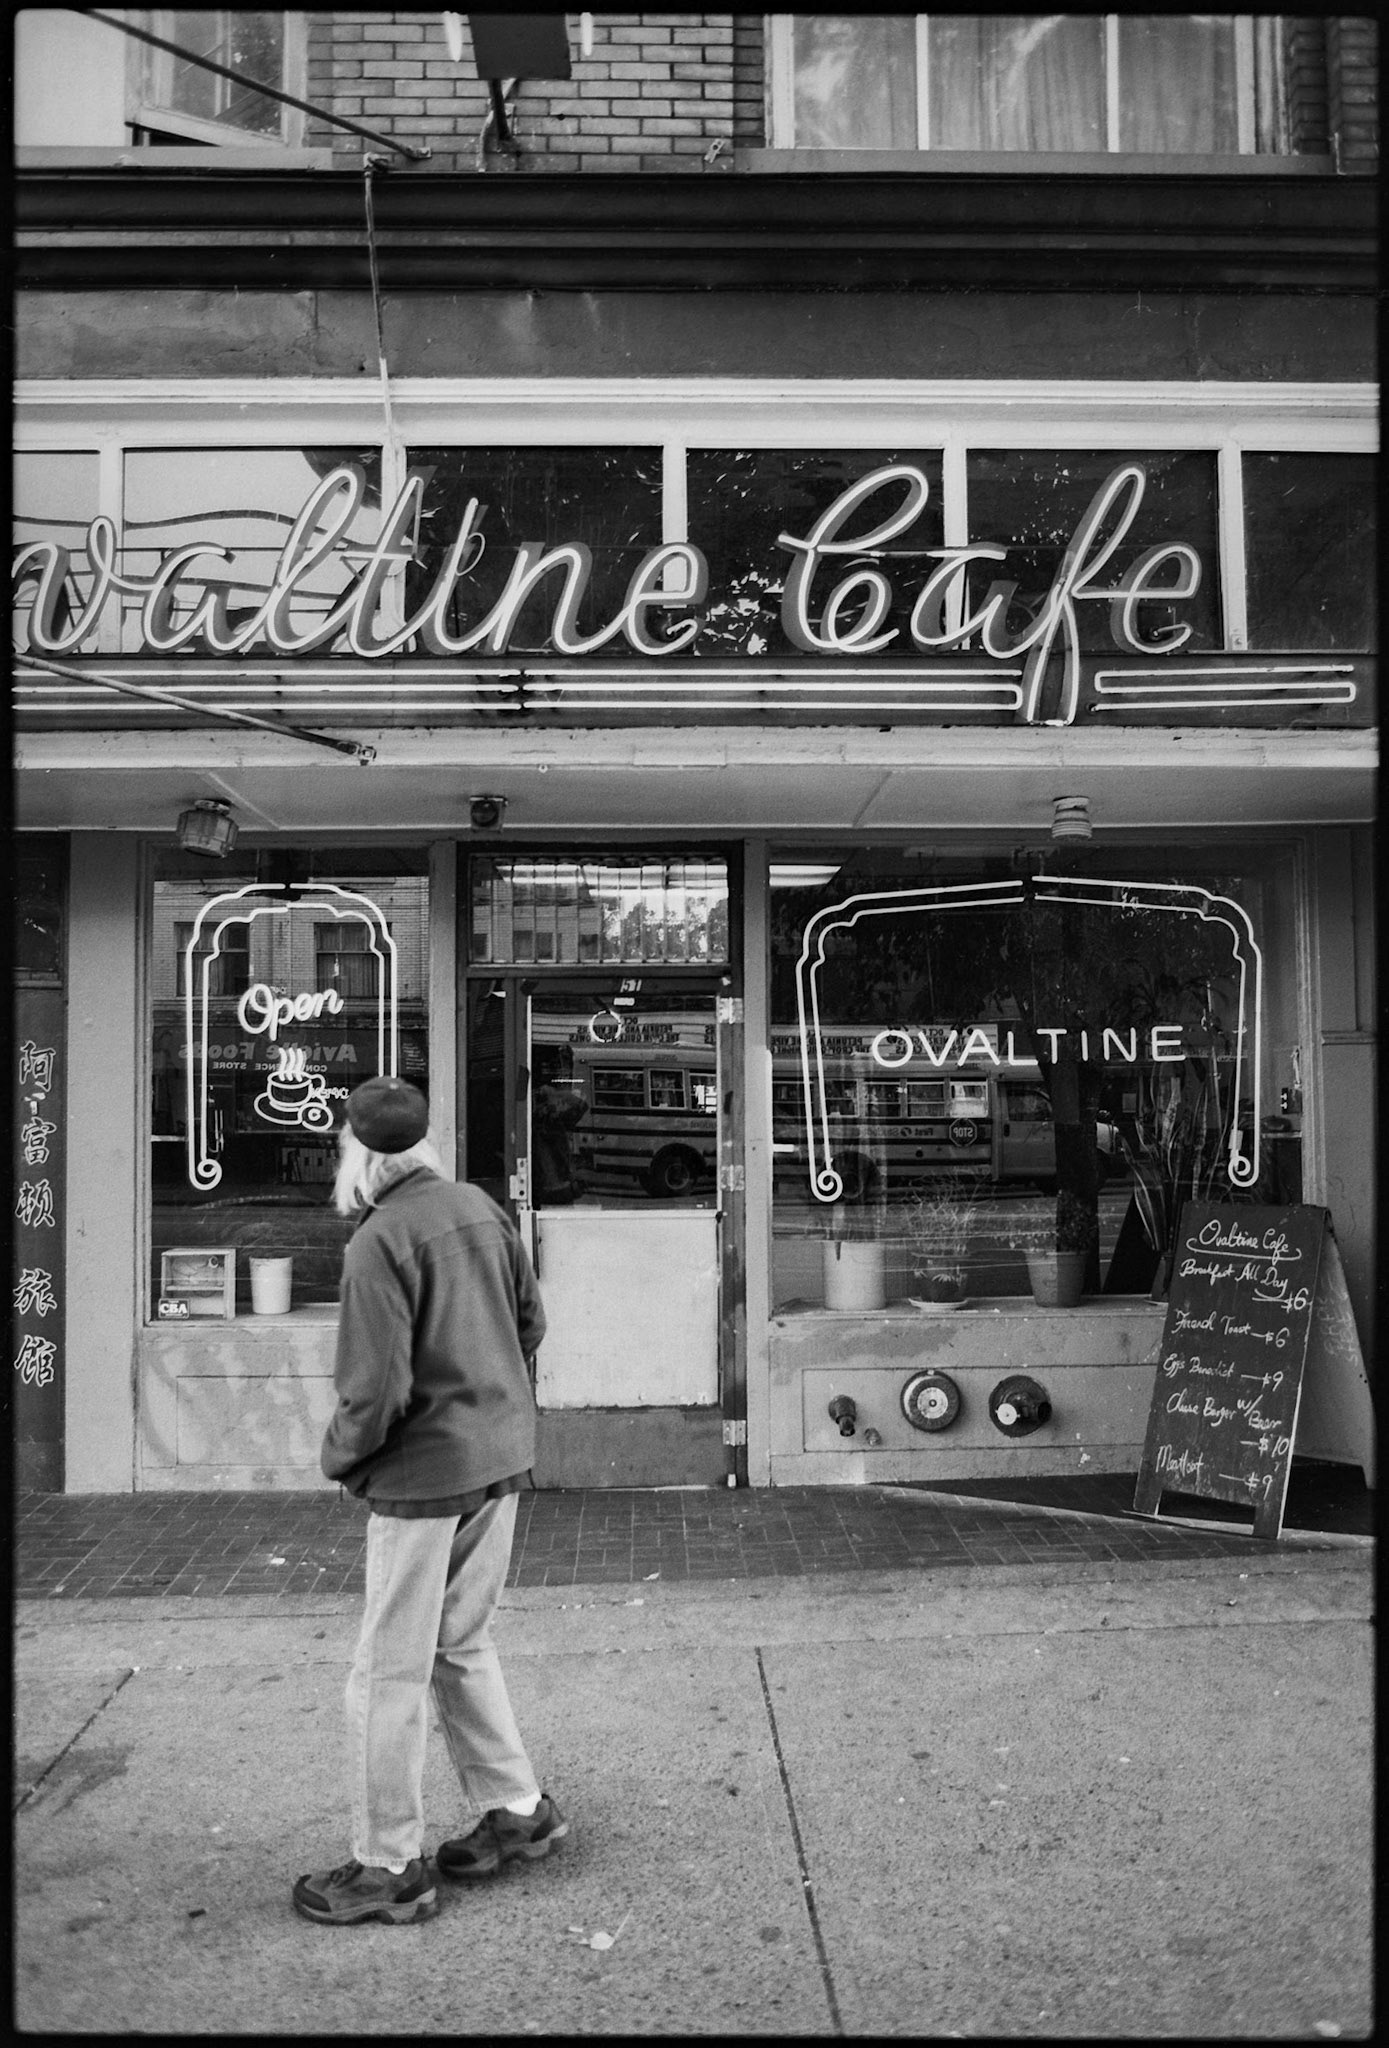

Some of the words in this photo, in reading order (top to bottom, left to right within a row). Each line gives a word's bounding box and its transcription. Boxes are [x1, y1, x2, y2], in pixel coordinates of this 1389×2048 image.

[778, 462, 1202, 726] Cafe
[237, 983, 345, 1041] Open
[871, 1025, 1186, 1068] OVALTINE
[1199, 1219, 1259, 1249] Ovaltine
[1263, 1228, 1289, 1266] Cafe
[1235, 1262, 1261, 1282] All
[1257, 1266, 1288, 1299] Day
[159, 1303, 188, 1314] CBA
[1248, 1410, 1282, 1430] Beer
